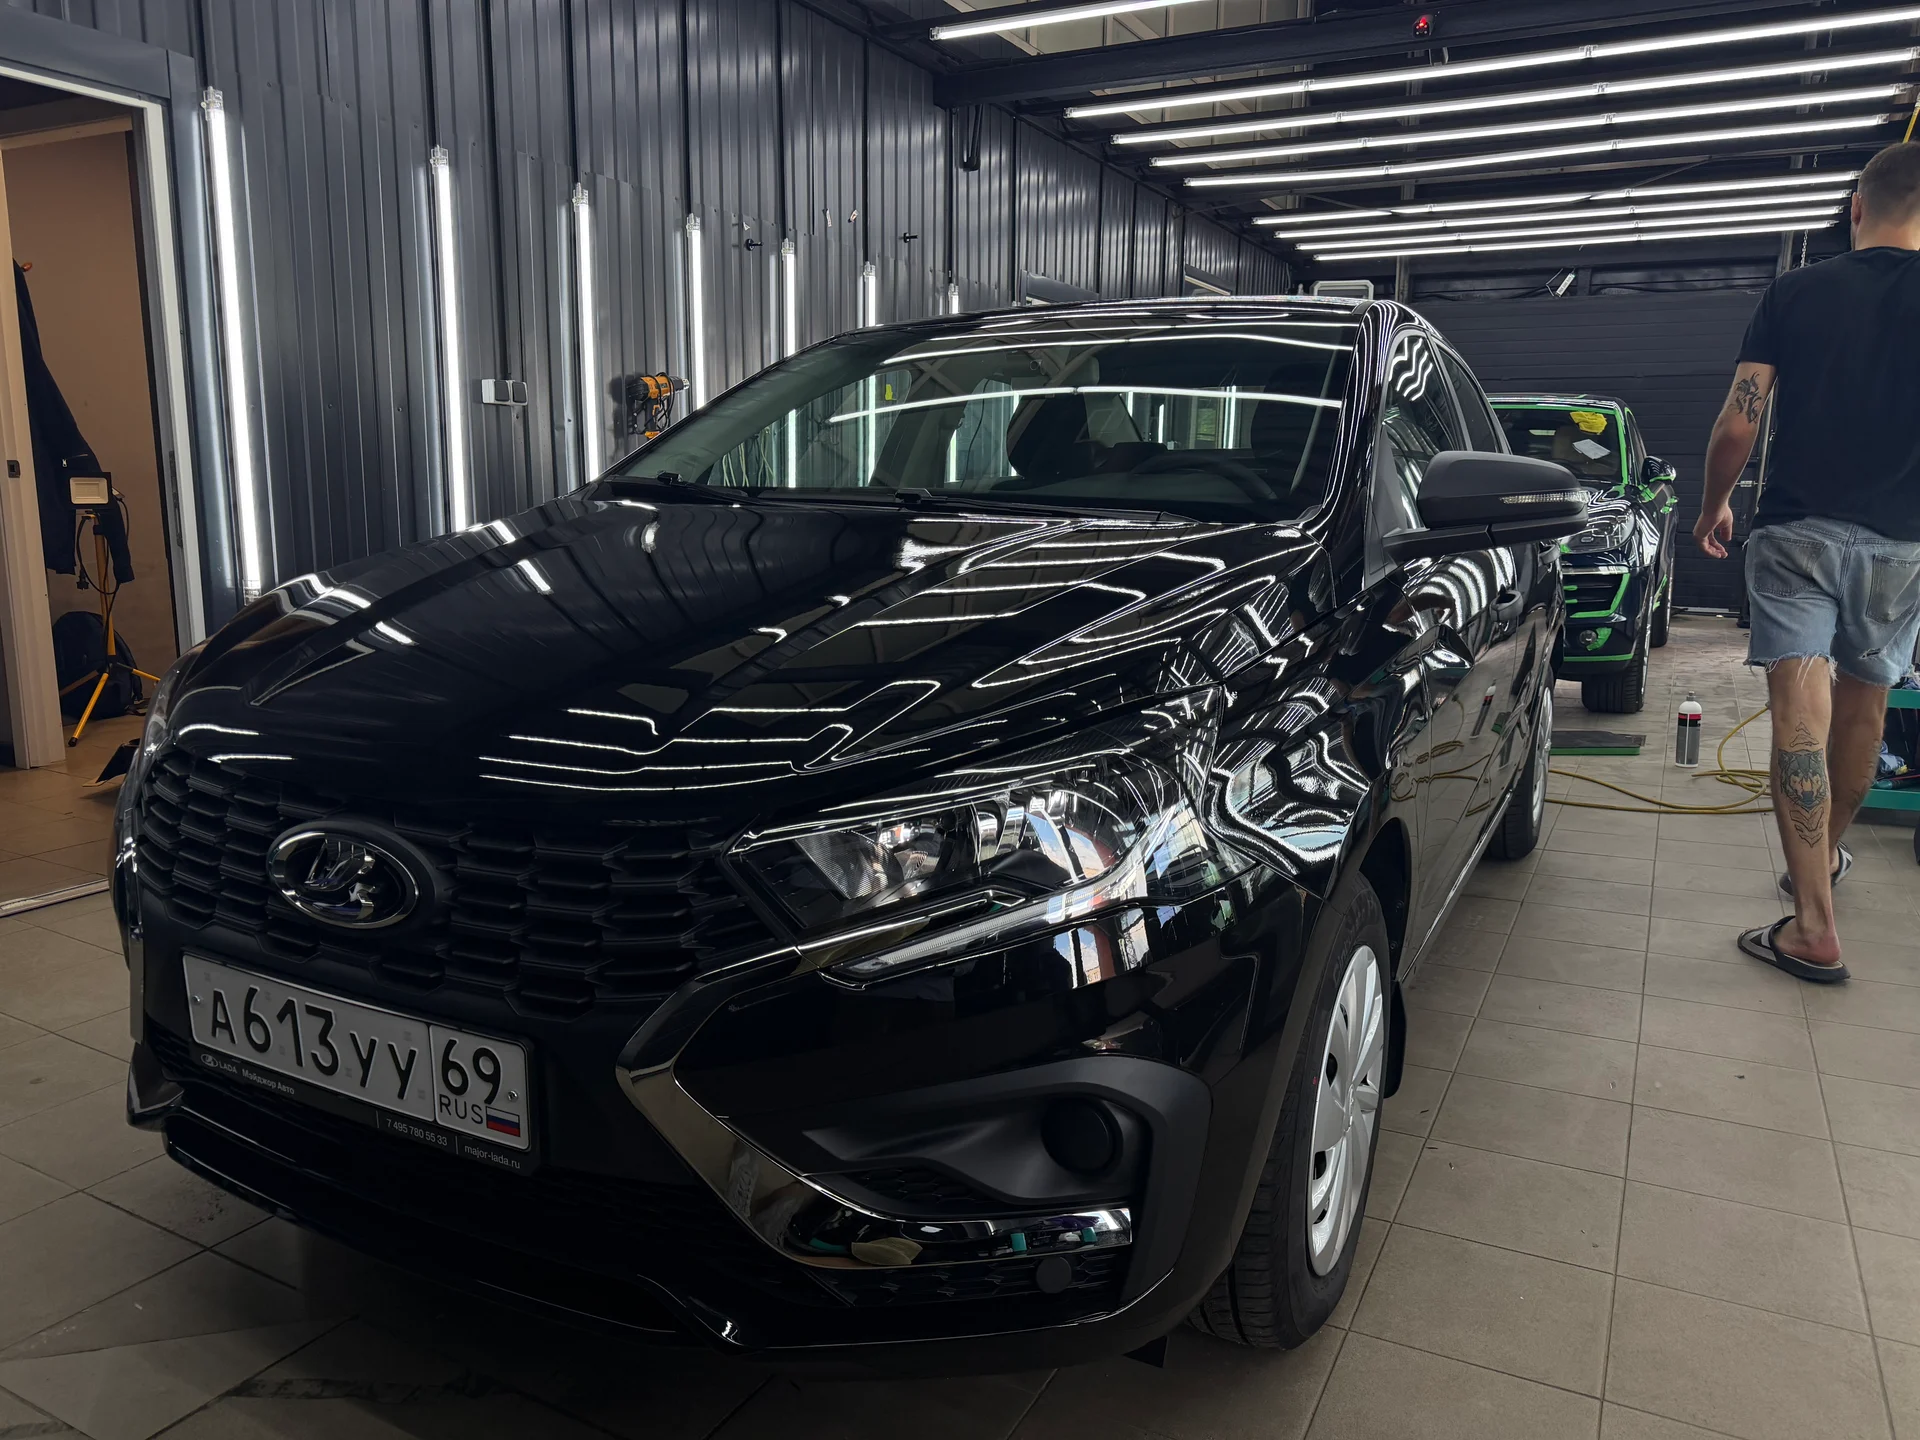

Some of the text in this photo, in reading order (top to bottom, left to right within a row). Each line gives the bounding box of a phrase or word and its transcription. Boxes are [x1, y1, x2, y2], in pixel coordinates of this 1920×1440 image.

[219, 1061, 238, 1074] LADA
[442, 1038, 502, 1105] 69
[242, 1069, 295, 1095] Мэйджор Авто
[439, 1094, 484, 1125] RUS
[464, 1145, 520, 1169] major-lada.ru
